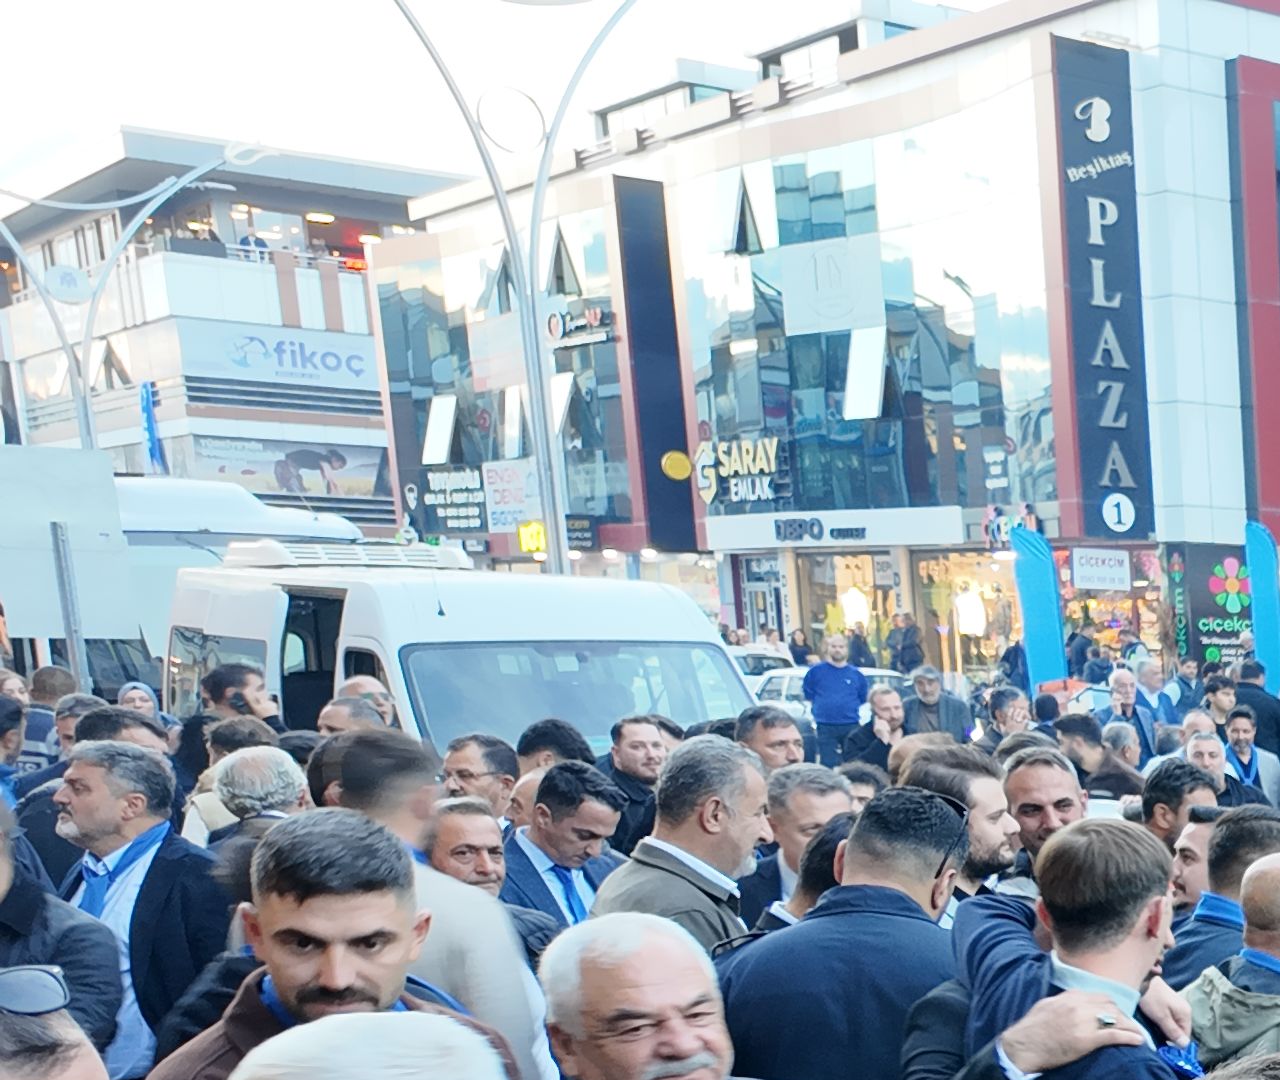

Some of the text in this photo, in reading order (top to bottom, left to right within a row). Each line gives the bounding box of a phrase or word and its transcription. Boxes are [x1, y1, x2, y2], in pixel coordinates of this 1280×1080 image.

[1066, 151, 1133, 182] Beşiktaş
[273, 340, 366, 378] fikoç
[1087, 197, 1137, 488] PLAZA
[717, 437, 778, 477] SARAY
[730, 475, 777, 502] EMLAK
